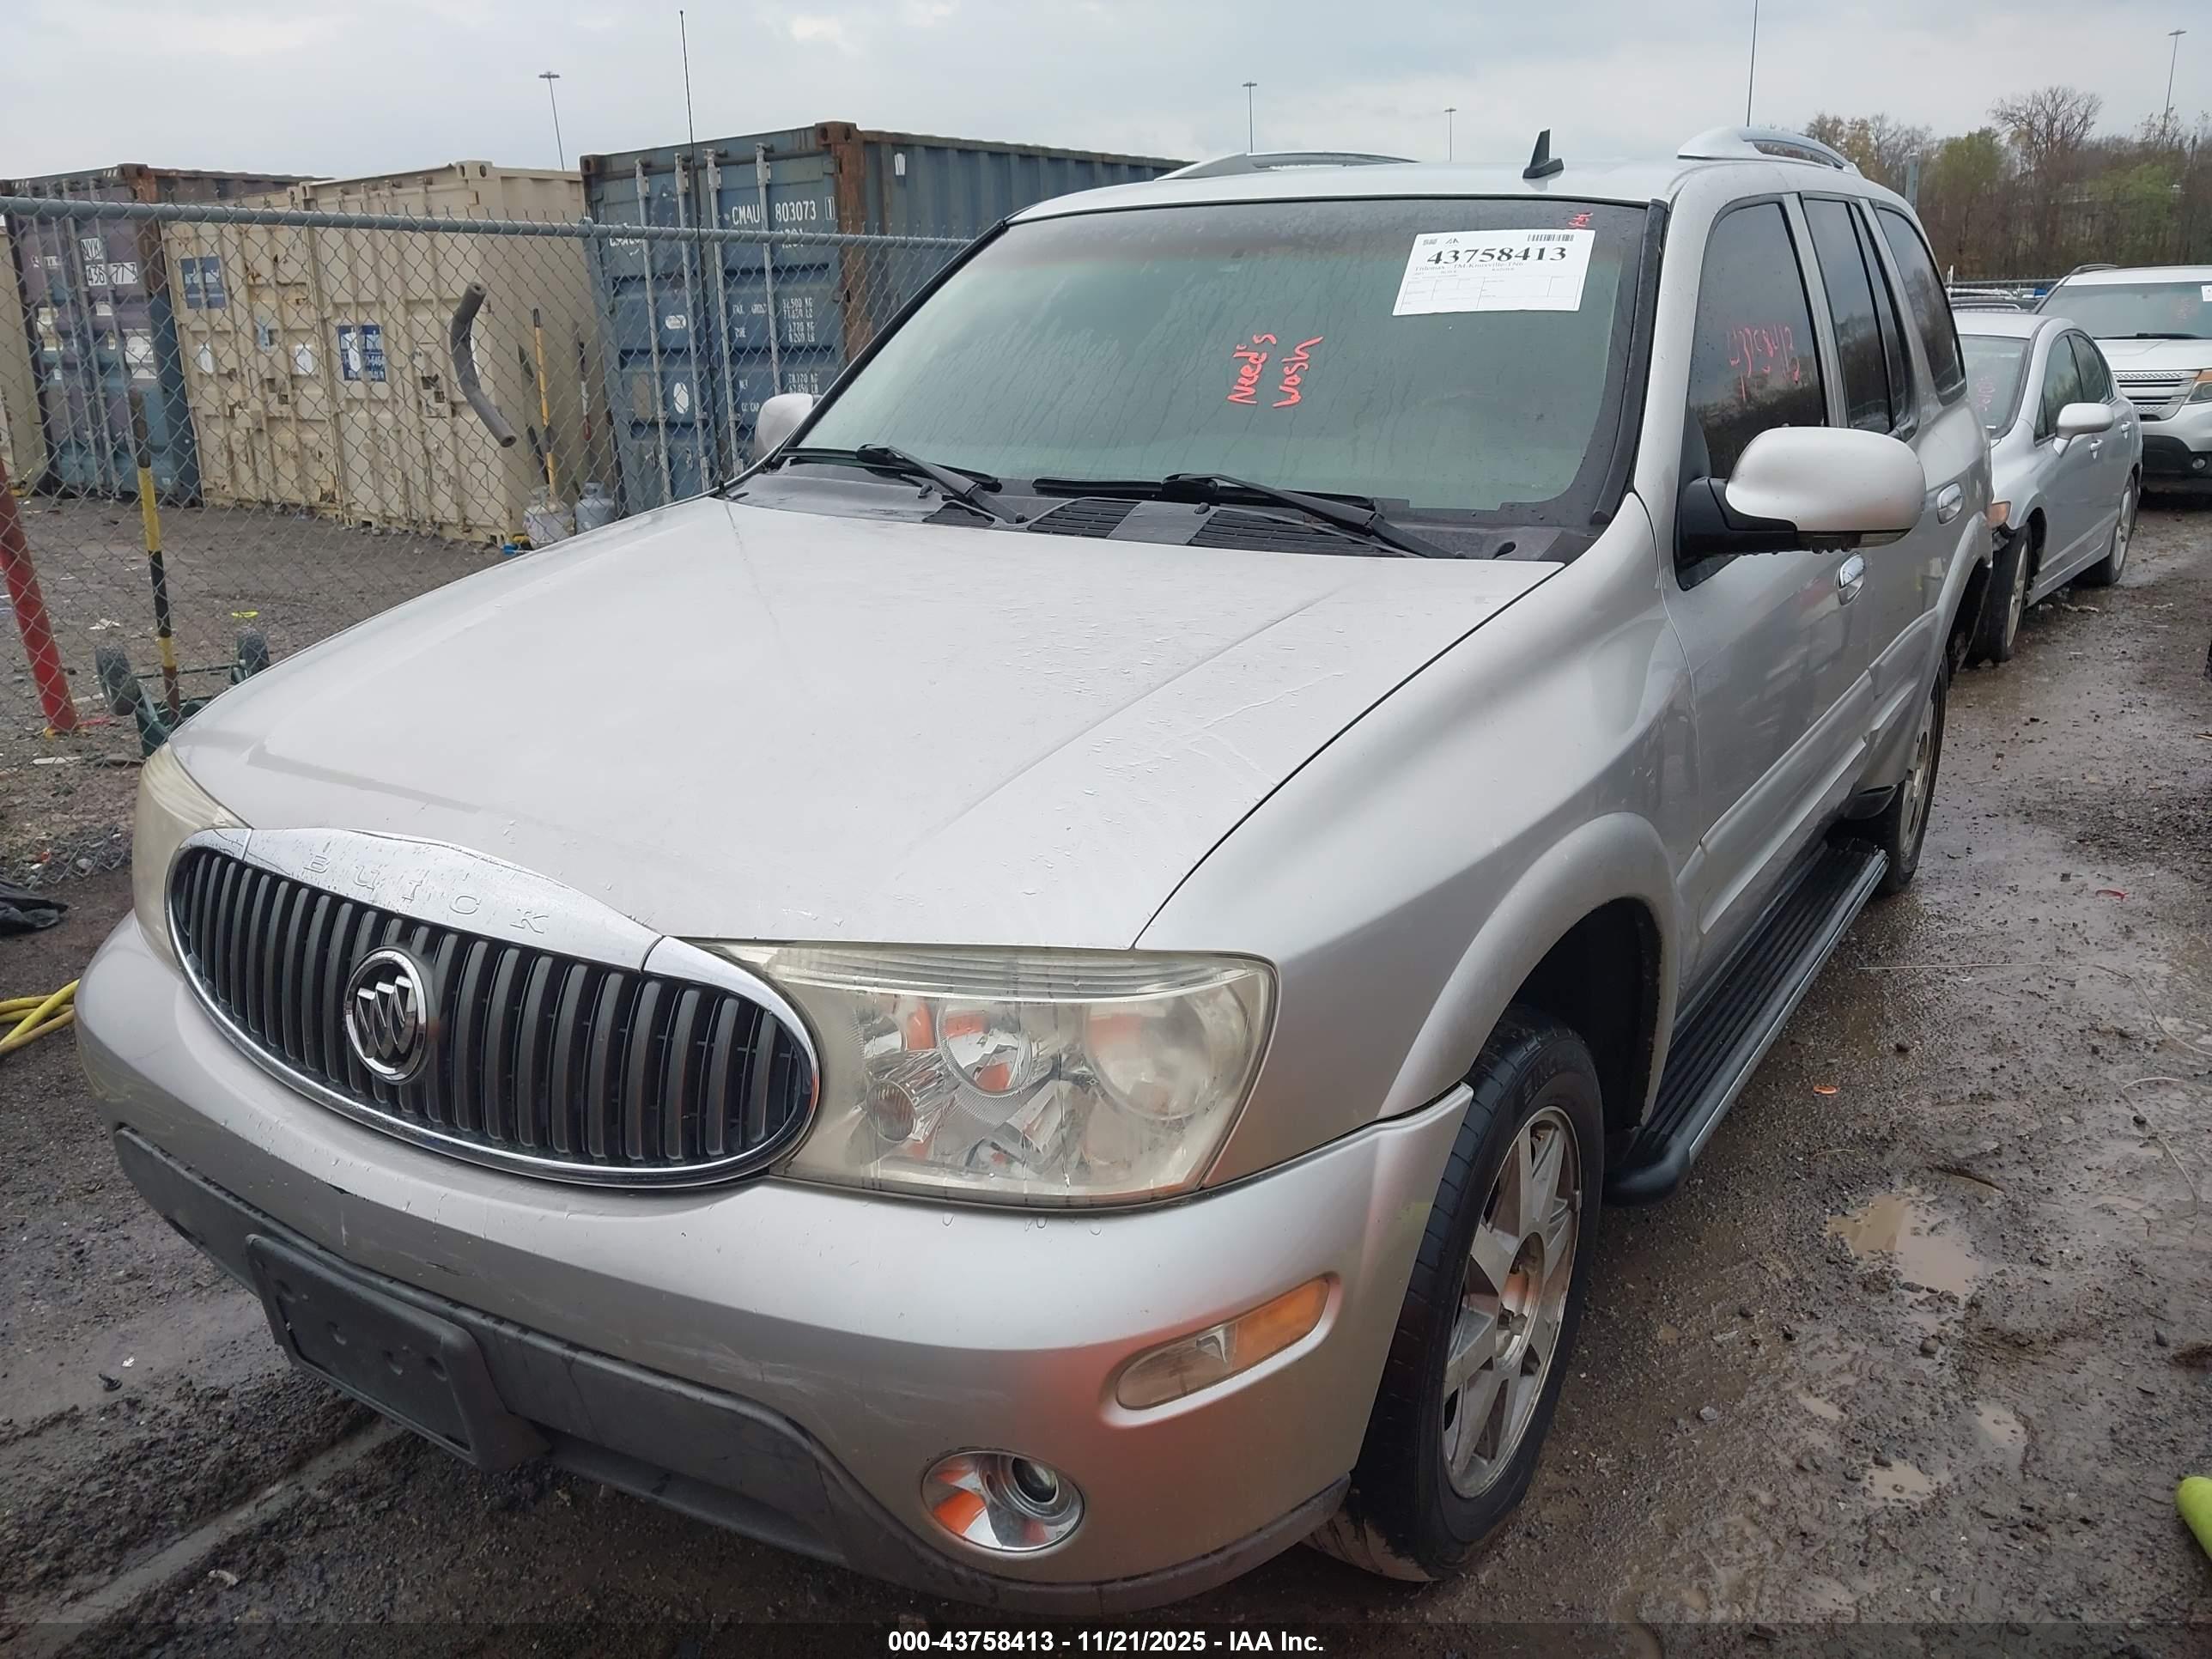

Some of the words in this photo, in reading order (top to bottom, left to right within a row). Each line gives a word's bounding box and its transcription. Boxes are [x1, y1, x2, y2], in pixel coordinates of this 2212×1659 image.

[732, 204, 761, 225] CMAU
[775, 200, 817, 222] 803073
[1426, 246, 1566, 264] 43758413
[303, 854, 550, 934] BUICK
